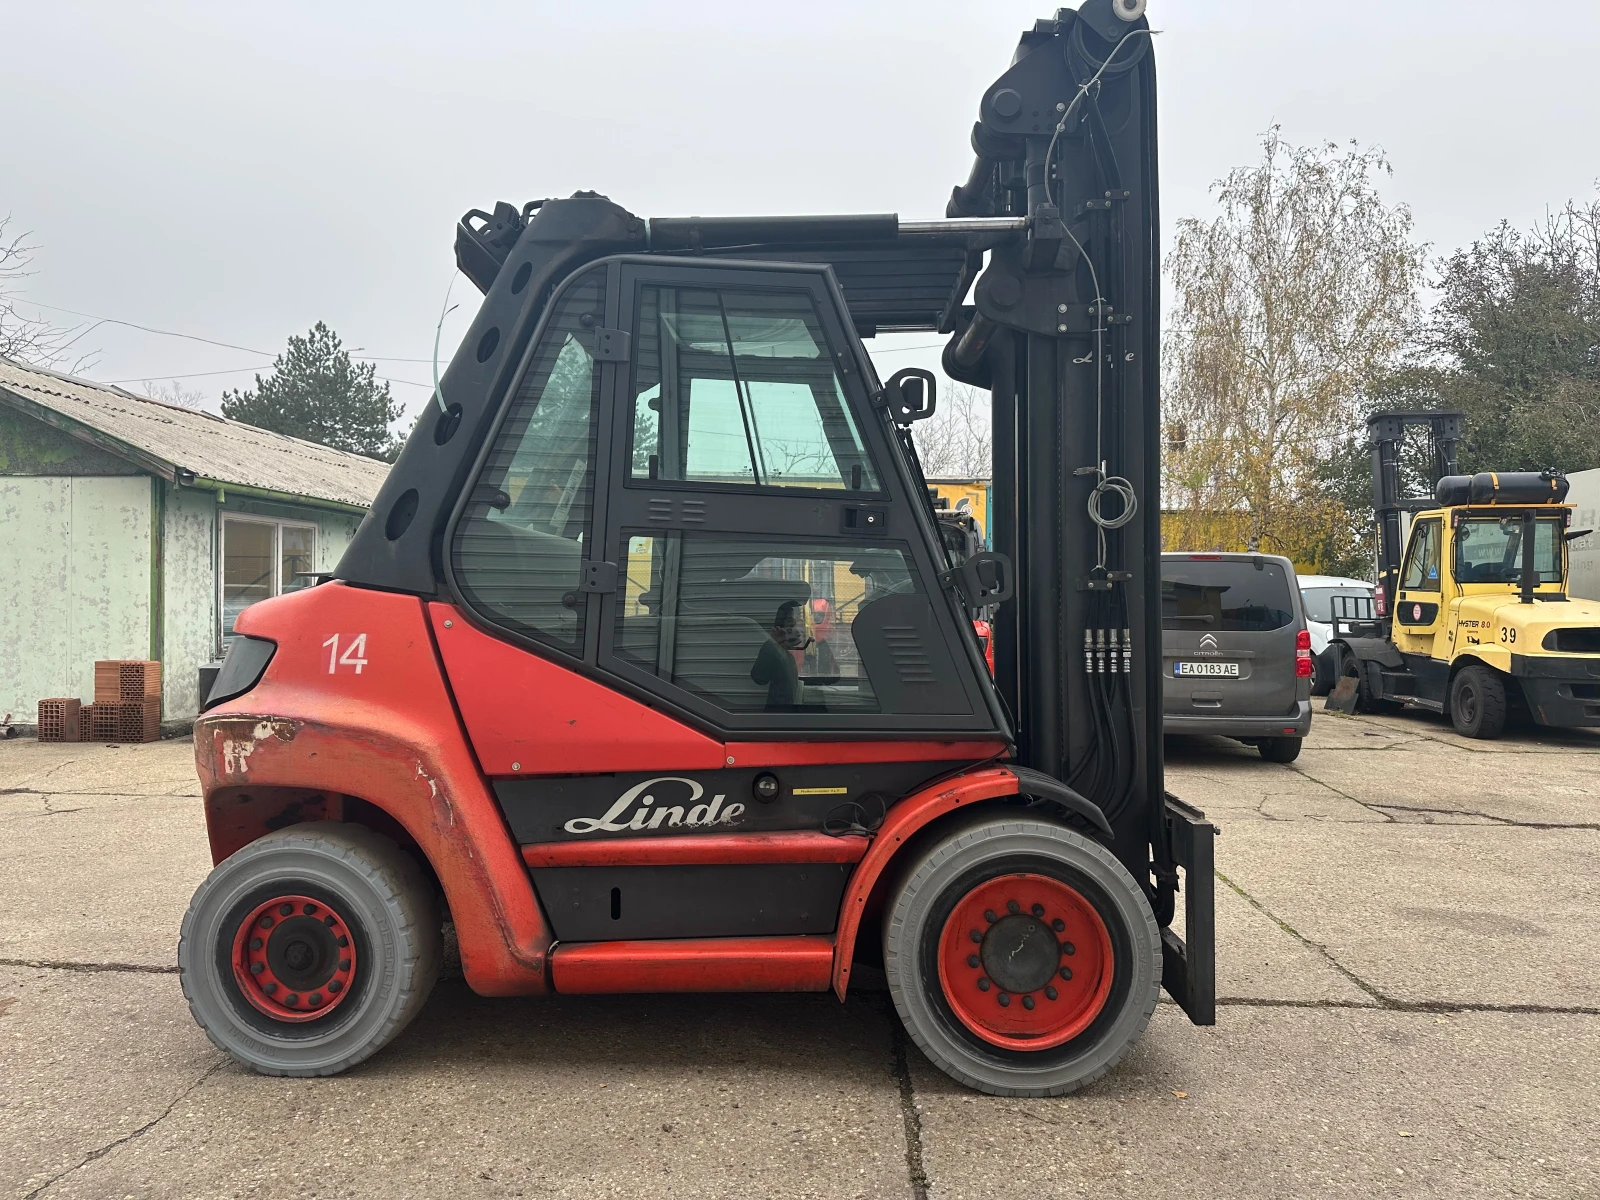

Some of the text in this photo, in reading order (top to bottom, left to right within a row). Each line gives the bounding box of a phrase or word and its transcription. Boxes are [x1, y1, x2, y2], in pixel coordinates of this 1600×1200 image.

[1458, 619, 1491, 629] HYSTER 8.0
[1501, 626, 1516, 643] 39
[322, 633, 368, 674] 14
[1181, 663, 1195, 673] EA
[1197, 664, 1222, 674] 0183
[1223, 664, 1237, 675] AE
[563, 776, 746, 834] Linde
